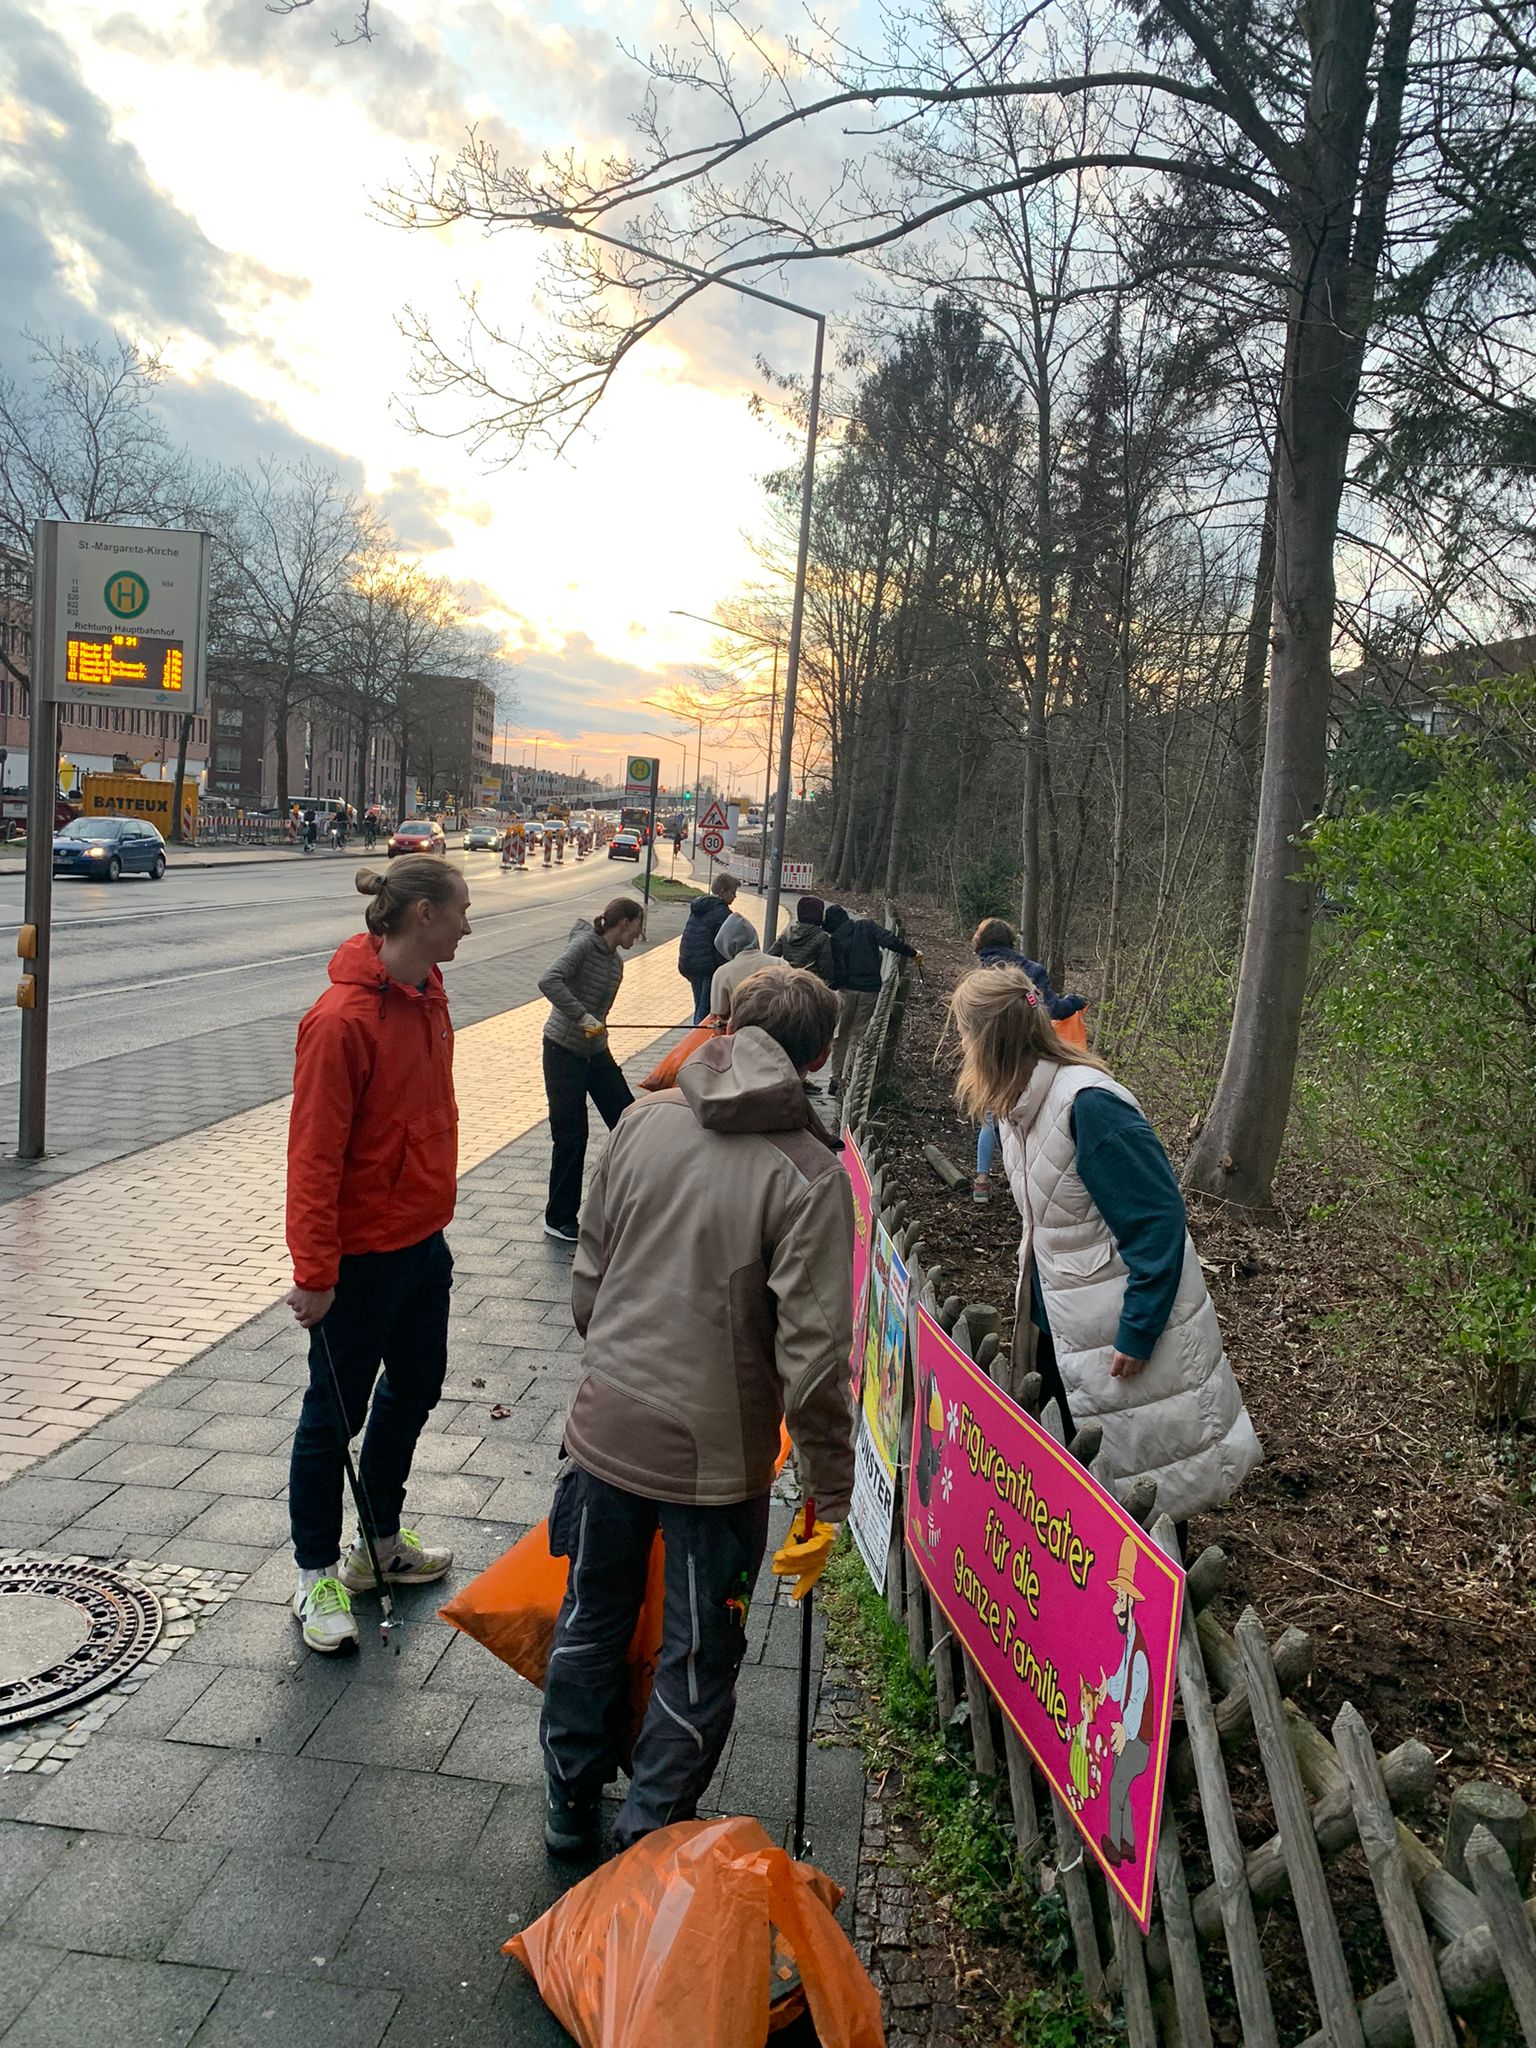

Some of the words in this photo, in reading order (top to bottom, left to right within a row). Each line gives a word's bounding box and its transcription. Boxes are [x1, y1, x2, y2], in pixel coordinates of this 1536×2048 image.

[79, 540, 179, 557] St.-Margareta-Kirche
[117, 581, 136, 609] H
[74, 621, 112, 632] Richtung
[114, 624, 175, 636] Hauptbahnhof
[93, 795, 168, 813] BATTEUX
[706, 837, 720, 849] 30
[959, 1402, 1095, 1588] Figurentheater
[985, 1508, 1011, 1573] für
[1012, 1545, 1040, 1619] die
[954, 1546, 1000, 1645] ganze
[1003, 1606, 1068, 1742] Familie
